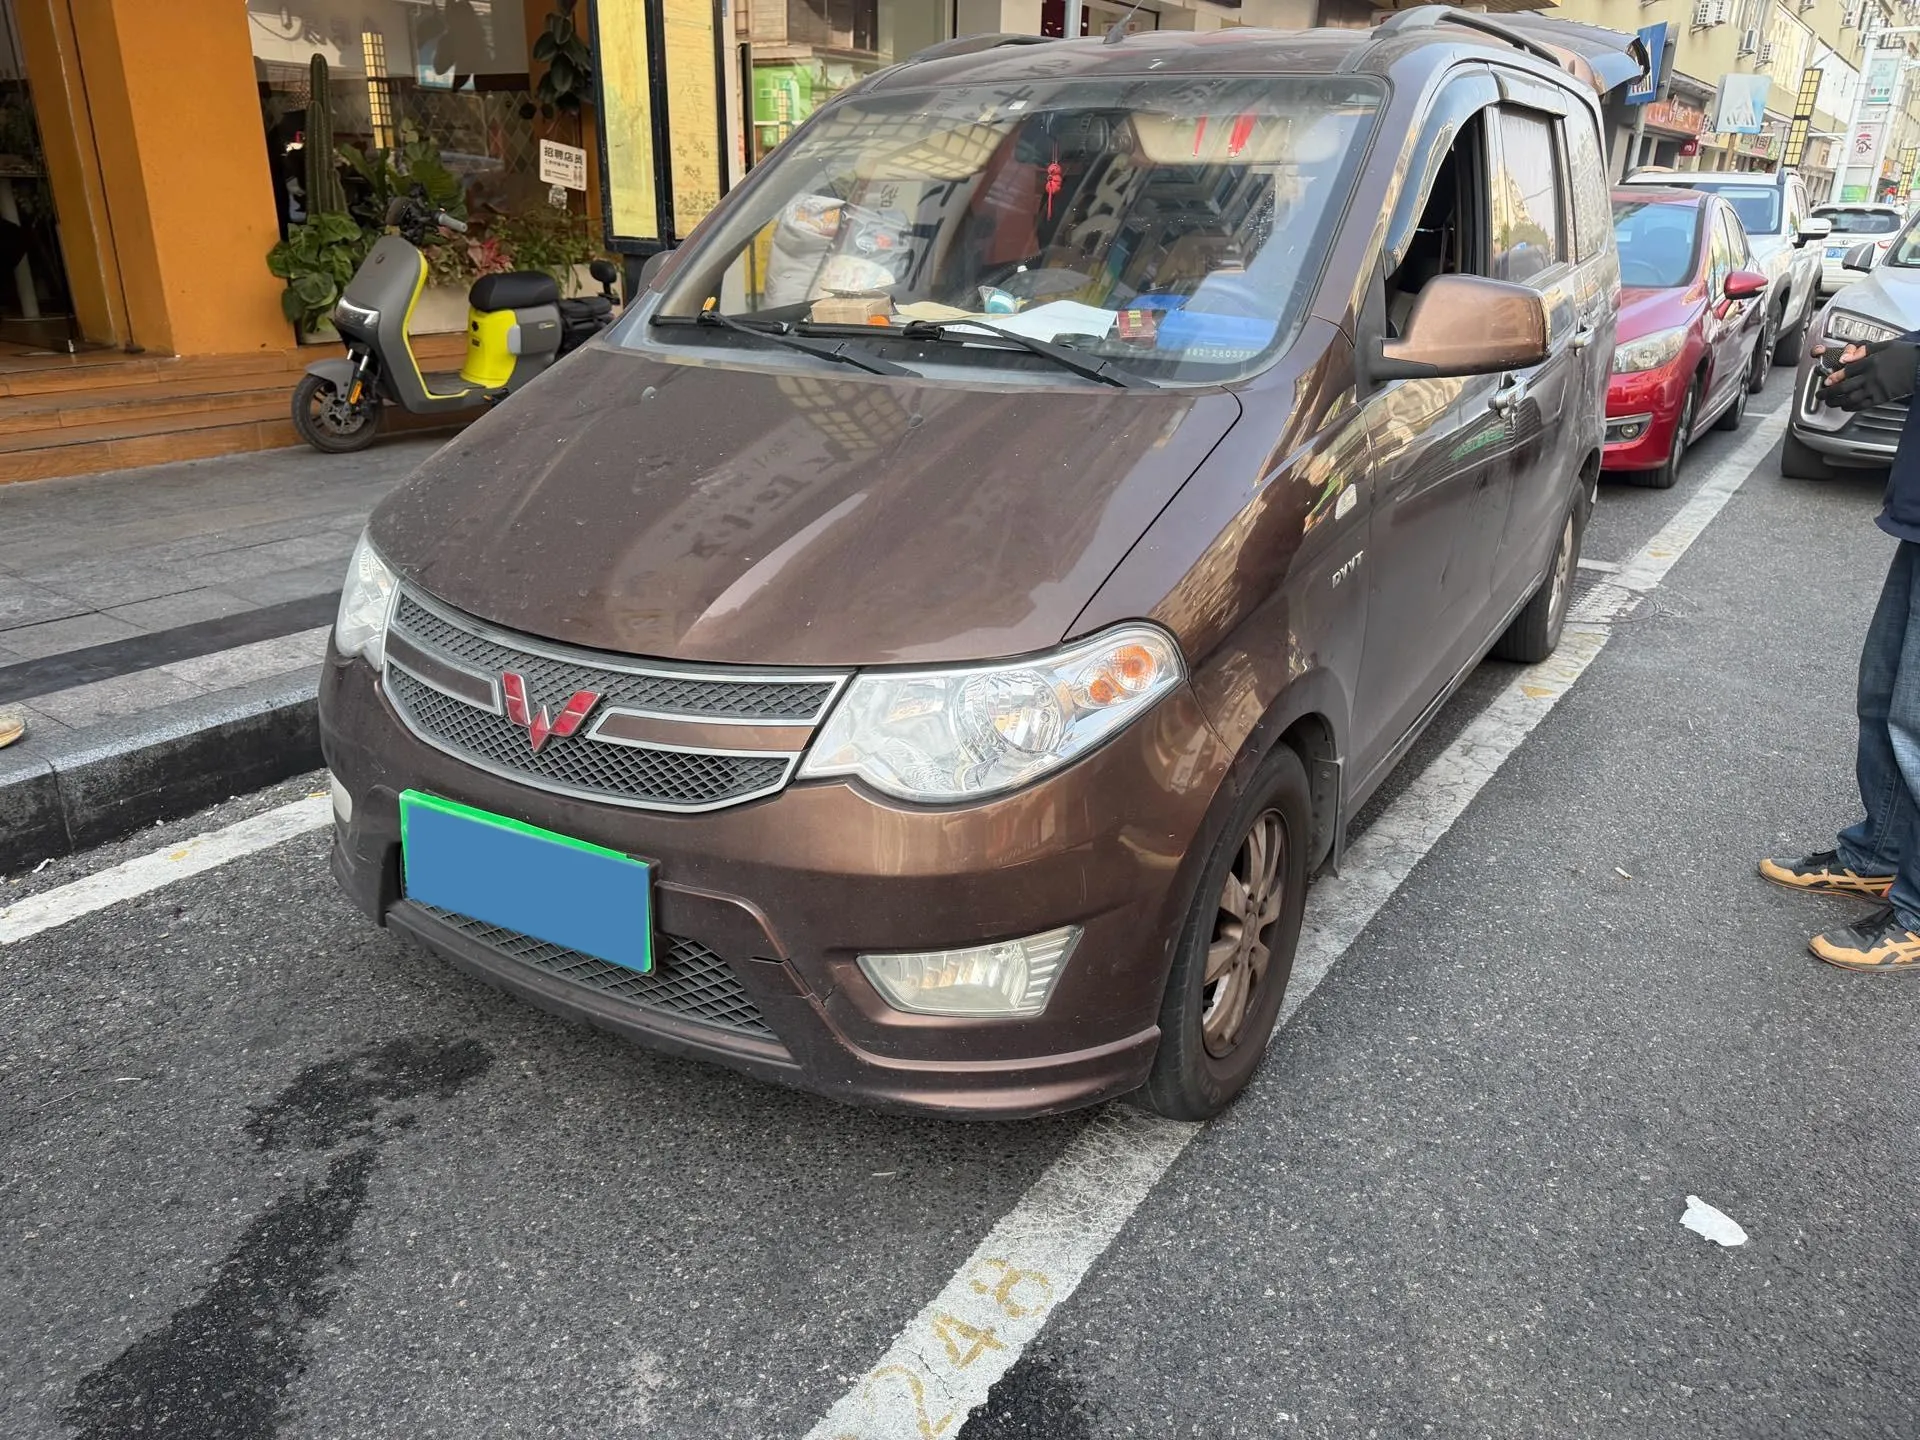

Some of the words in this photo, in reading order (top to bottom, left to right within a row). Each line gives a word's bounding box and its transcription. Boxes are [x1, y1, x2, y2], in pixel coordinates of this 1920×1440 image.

[544, 147, 583, 165] 招聘店员
[834, 1257, 1053, 1440] 248
